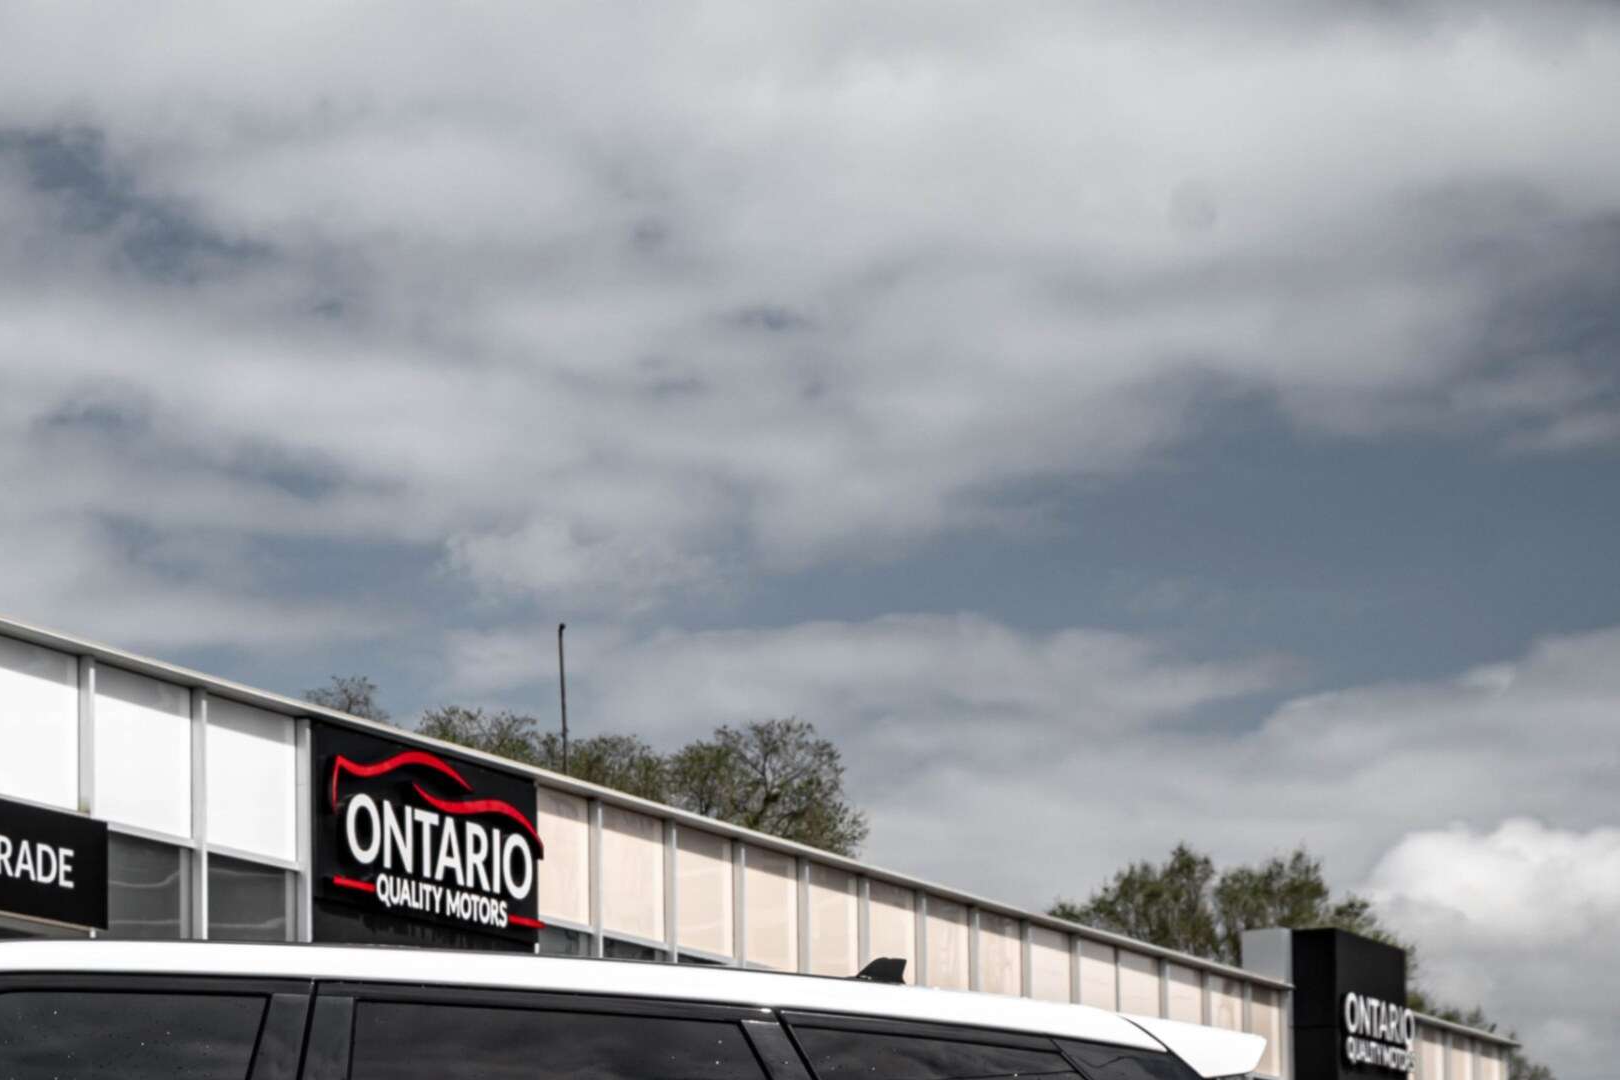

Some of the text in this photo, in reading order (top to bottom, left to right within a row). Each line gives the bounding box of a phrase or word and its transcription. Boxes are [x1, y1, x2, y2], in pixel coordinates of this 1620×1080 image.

[346, 793, 533, 900] ONTARIO
[375, 872, 509, 928] QUALITY MOTORS
[1344, 991, 1415, 1044] ONTARIO
[1345, 1035, 1382, 1065] QUALITY
